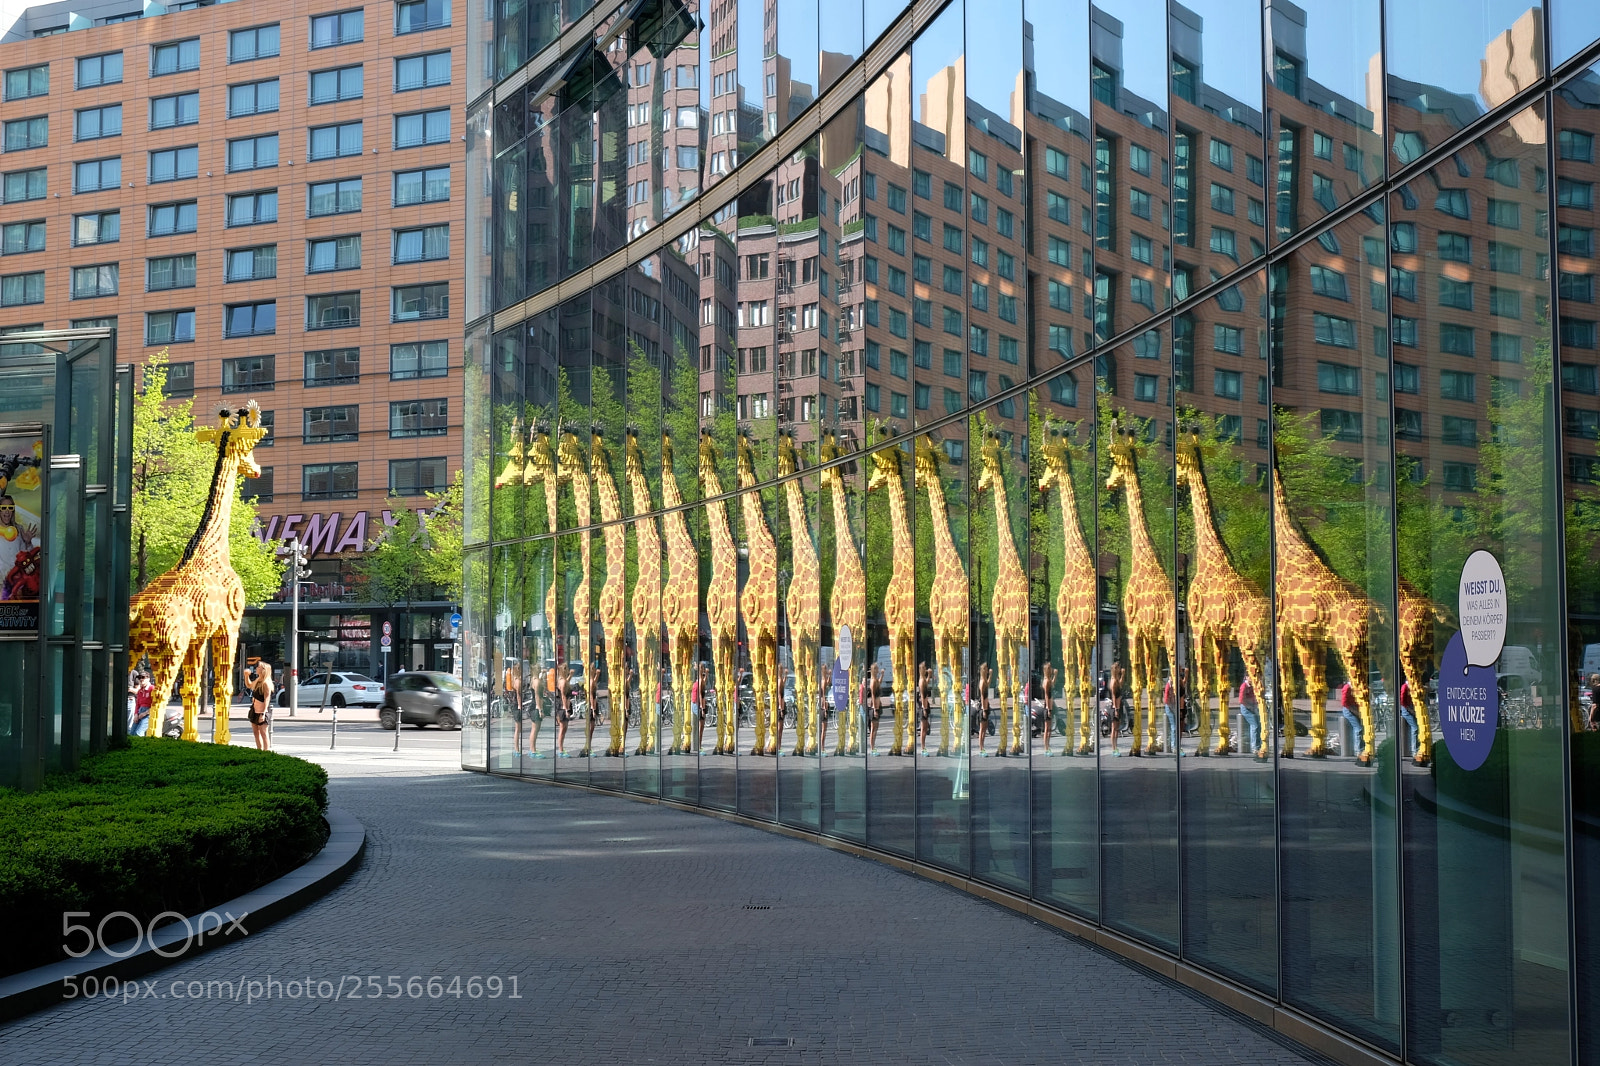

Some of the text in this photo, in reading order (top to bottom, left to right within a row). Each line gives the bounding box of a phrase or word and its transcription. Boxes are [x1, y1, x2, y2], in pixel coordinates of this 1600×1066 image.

[310, 582, 344, 597] Berlin
[1464, 579, 1502, 595] WEISST DU,
[1466, 599, 1500, 611] WAS ALLES IN
[1463, 613, 1504, 626] DEINEM KÖRPER
[1471, 630, 1497, 641] PASSIERT?
[1446, 687, 1487, 700] ENTDECKE ES
[1448, 702, 1485, 724] IN KÜRZE
[1460, 728, 1476, 741] HIER!
